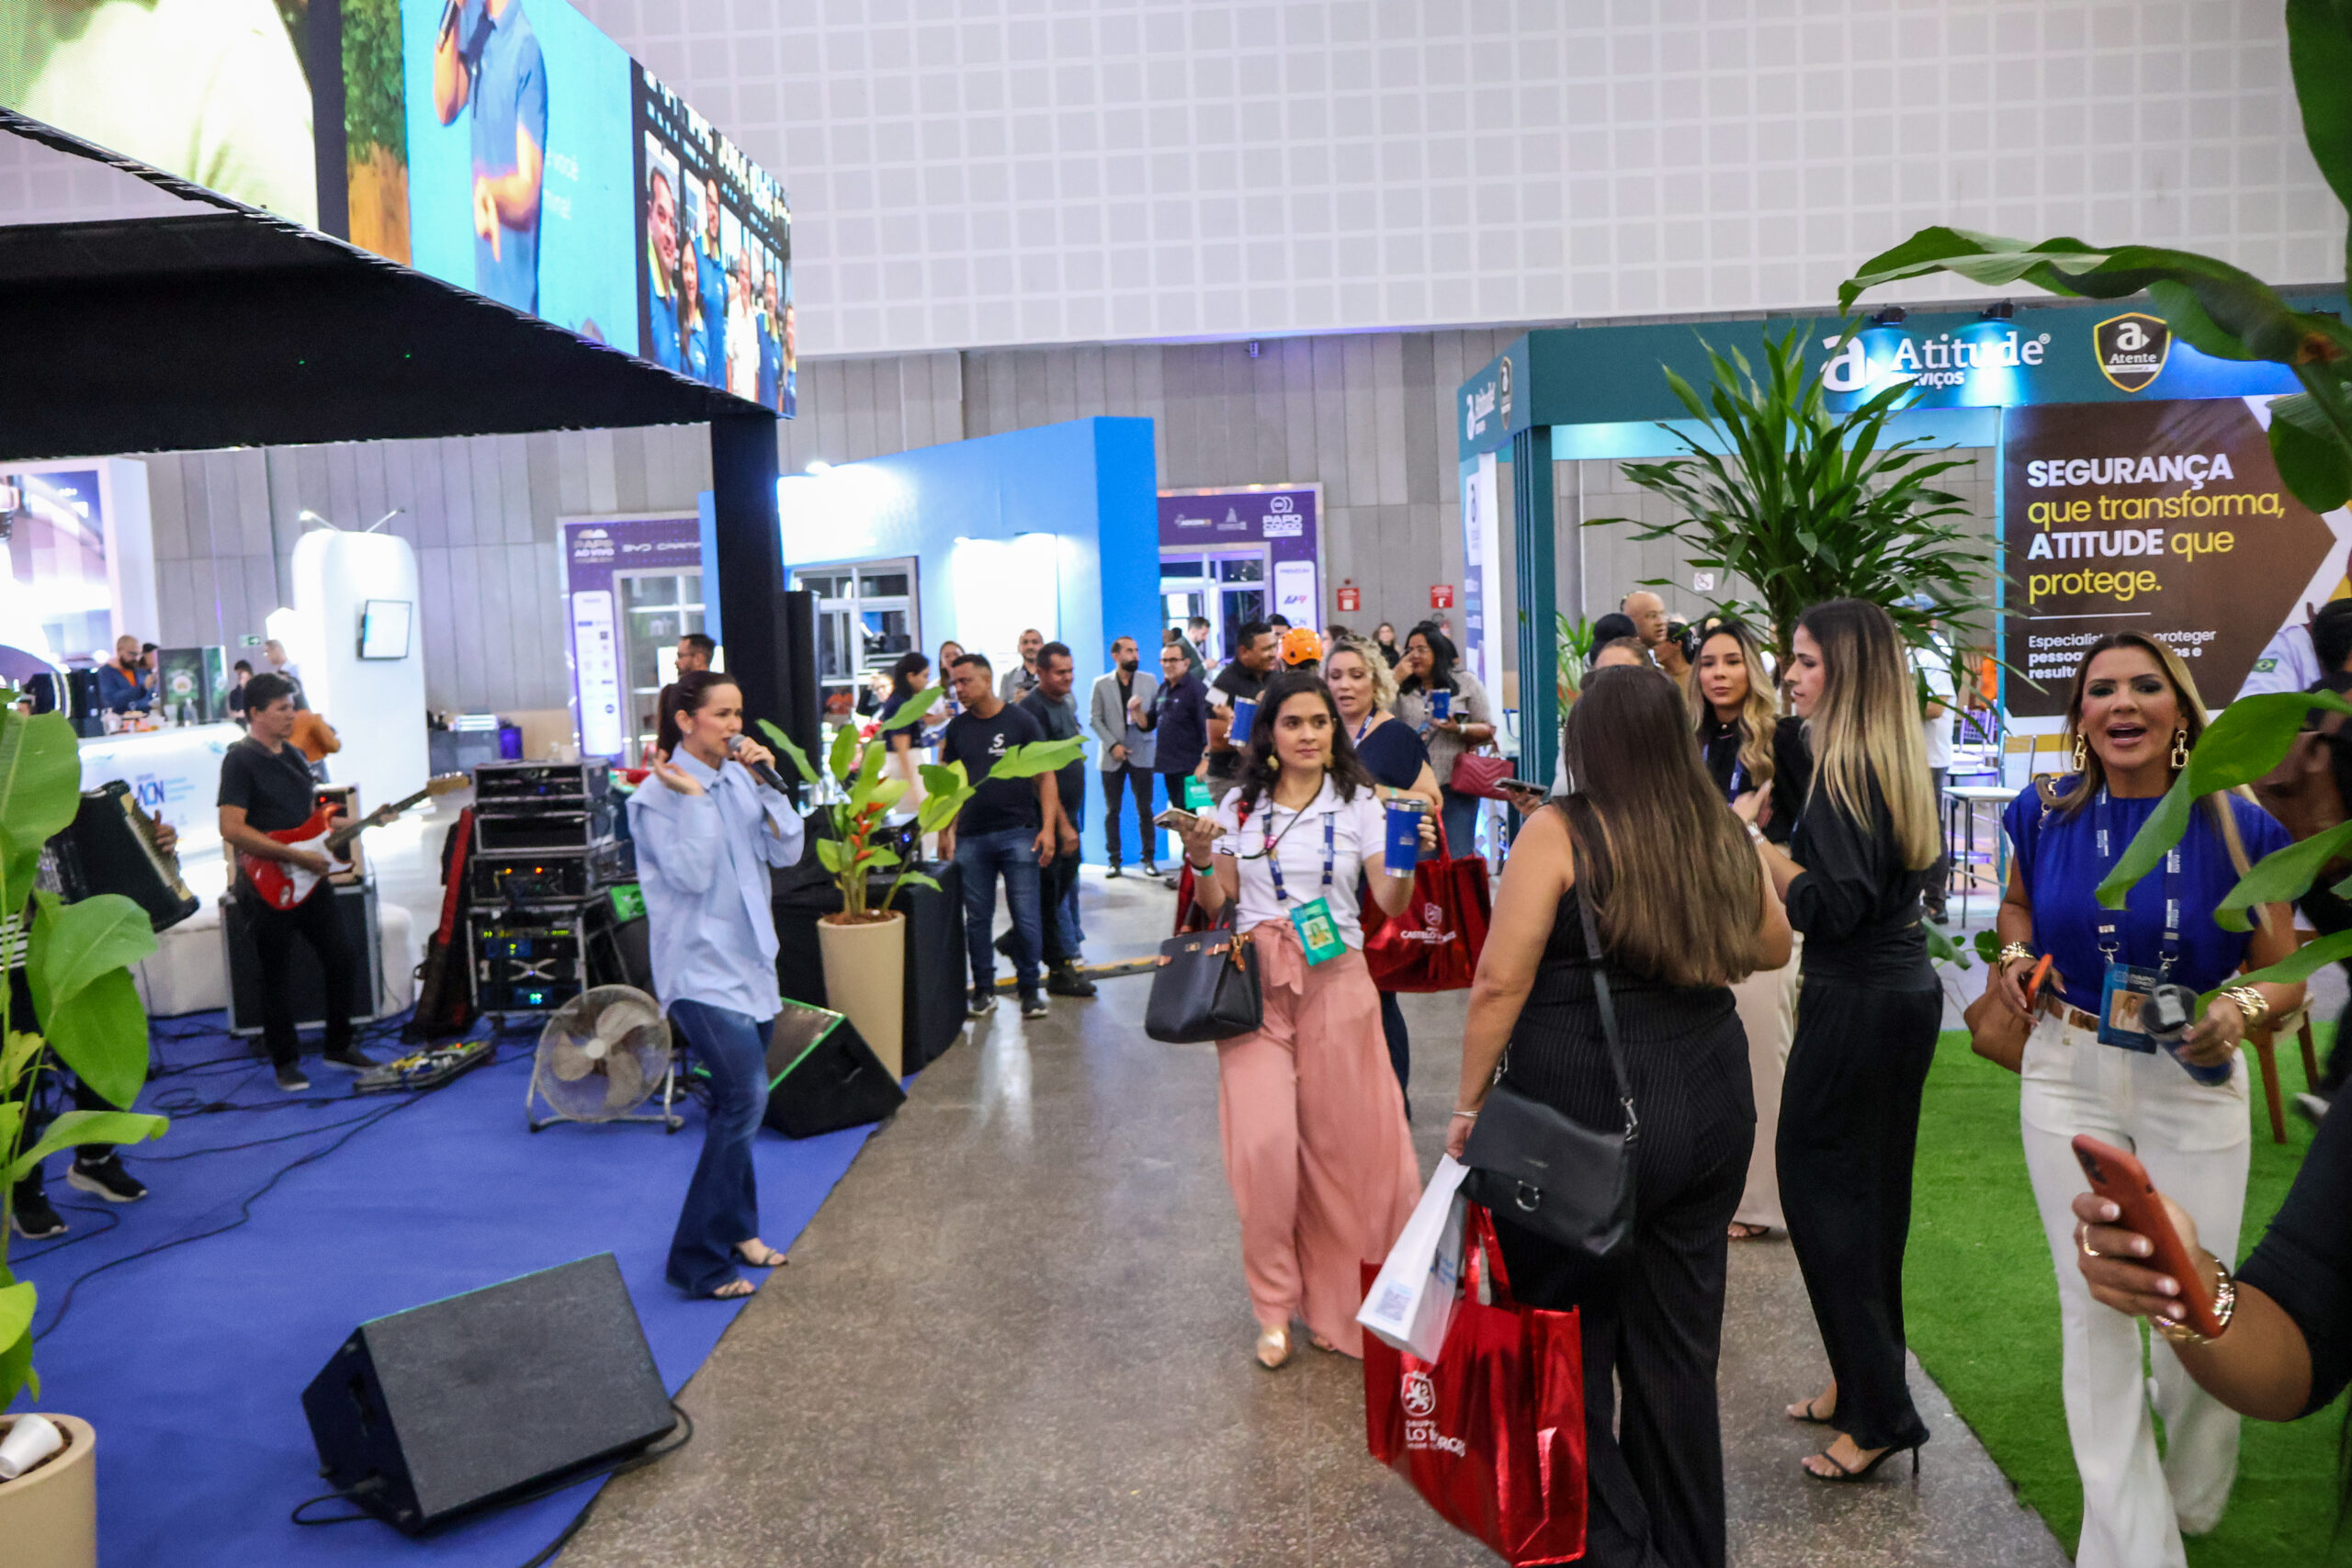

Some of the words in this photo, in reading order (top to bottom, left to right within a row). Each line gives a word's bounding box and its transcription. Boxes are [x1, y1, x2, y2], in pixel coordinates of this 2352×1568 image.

[2109, 353, 2157, 364] Atente
[2027, 453, 2234, 491] SEGURANÇA
[2027, 500, 2092, 532] que
[2098, 489, 2286, 521] transforma,
[2027, 528, 2165, 560] ATITUDE
[2170, 530, 2234, 562] que
[2029, 568, 2162, 604] protege.
[2192, 647, 2202, 658] e
